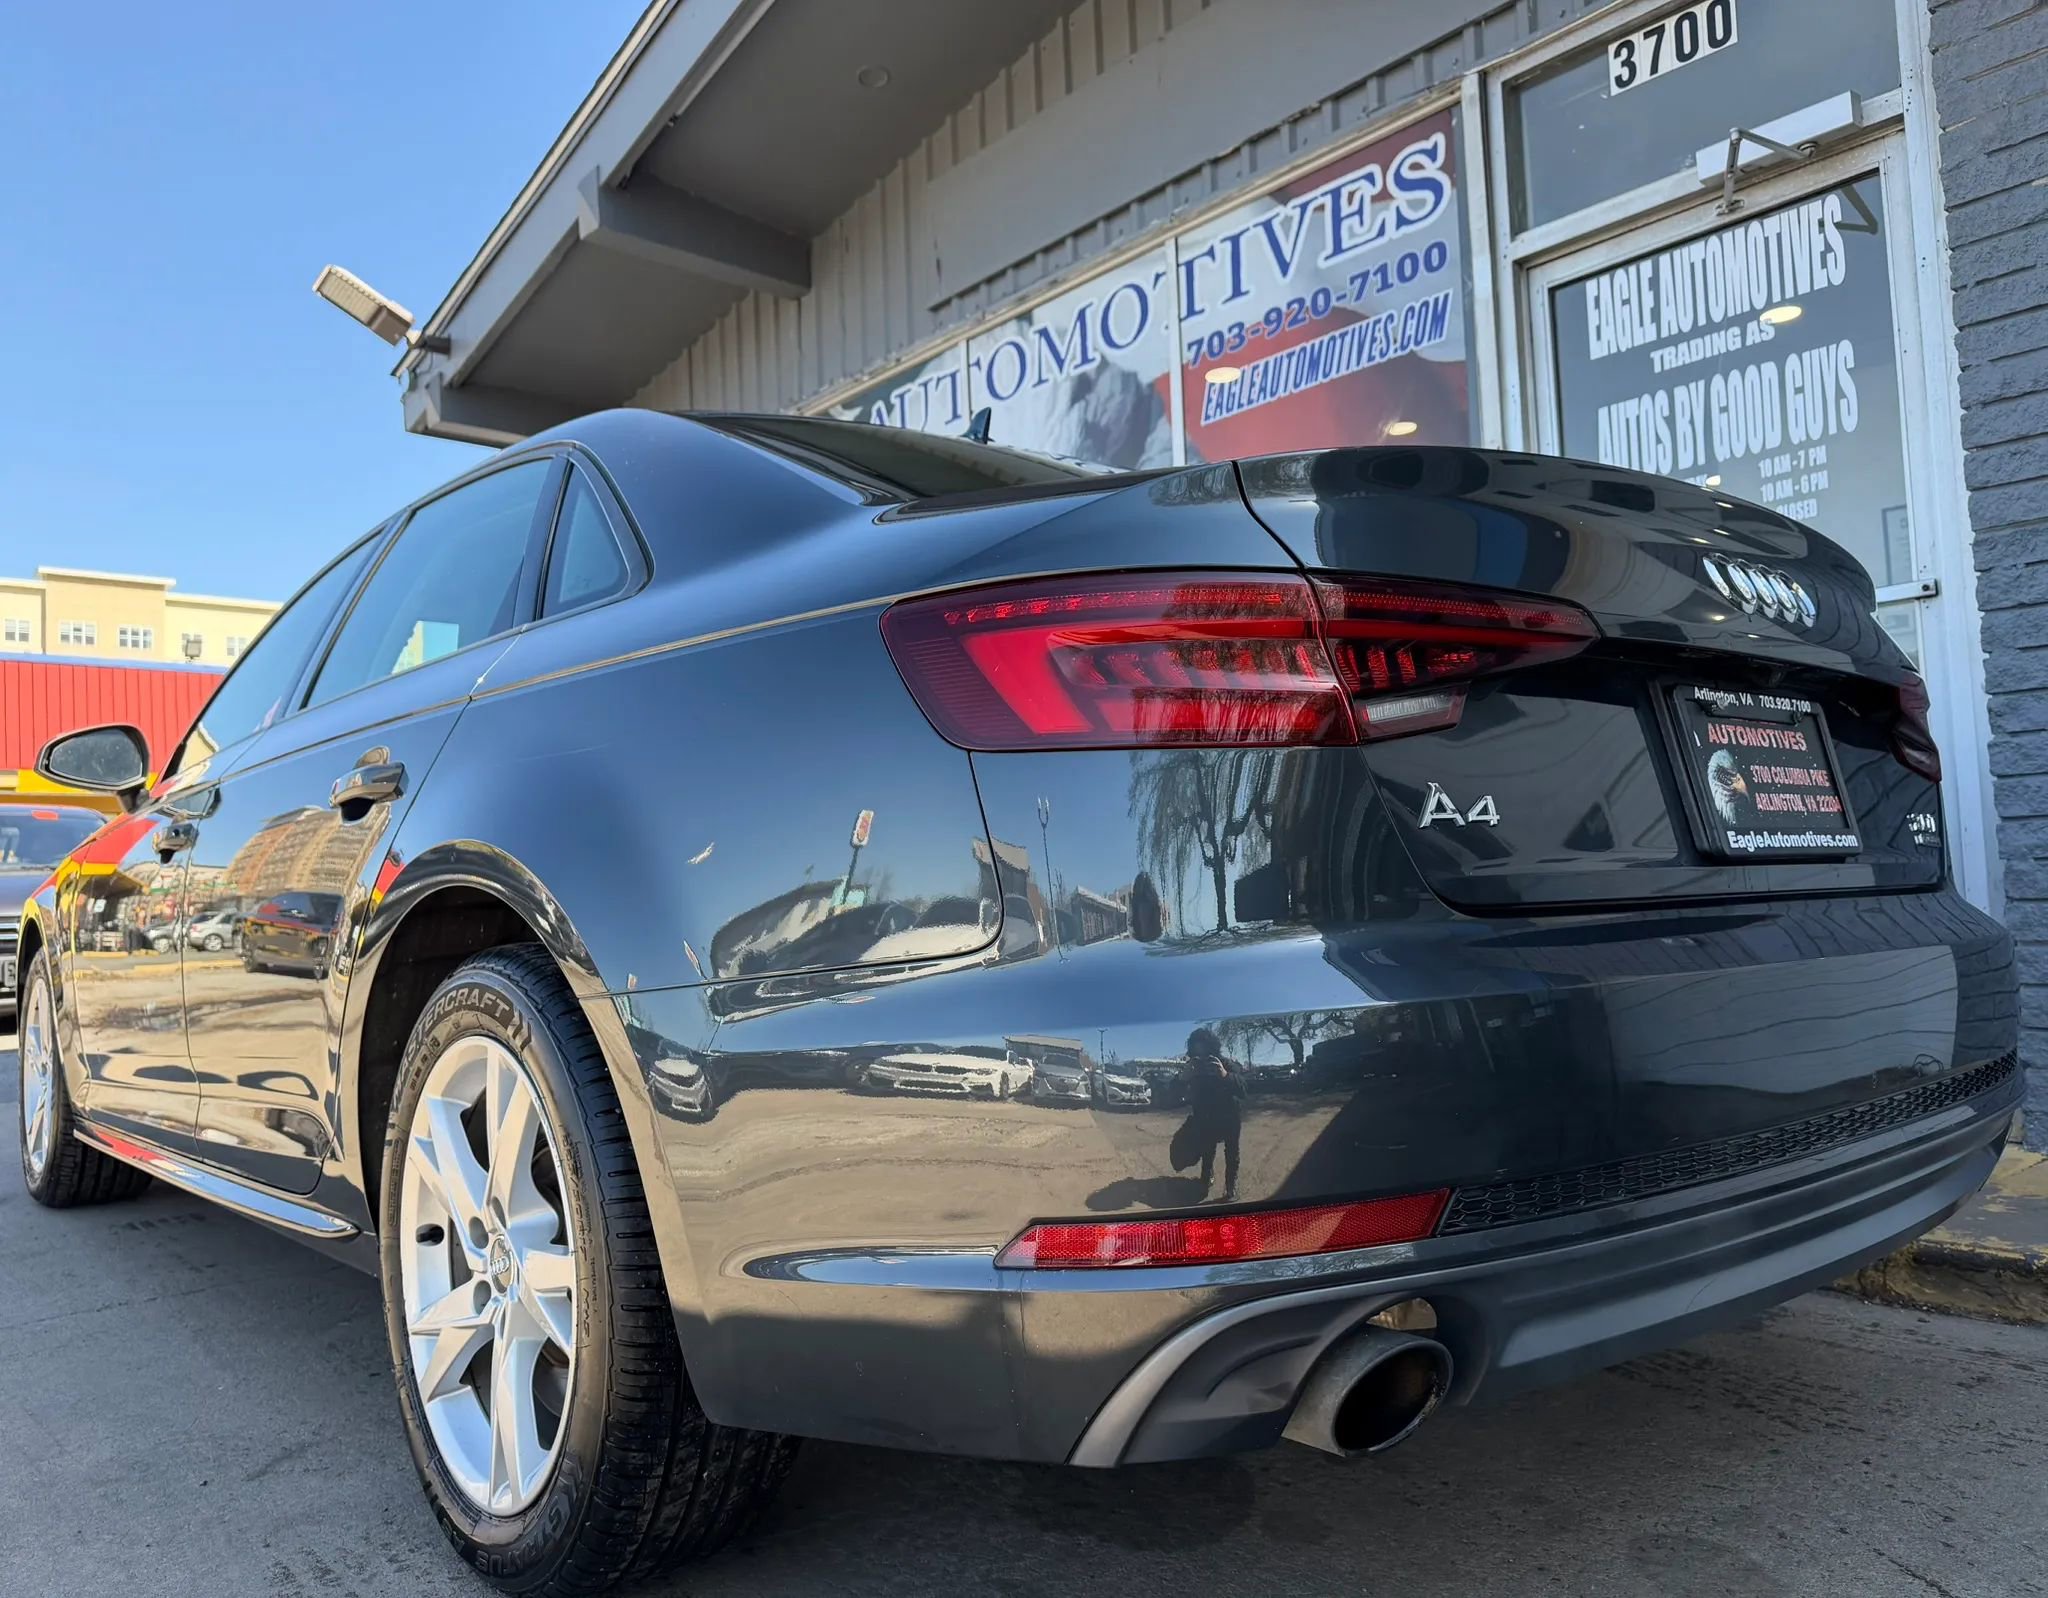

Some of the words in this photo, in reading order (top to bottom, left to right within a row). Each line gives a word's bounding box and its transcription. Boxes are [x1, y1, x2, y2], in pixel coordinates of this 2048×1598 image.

[1613, 0, 1732, 88] 3700
[1585, 259, 1657, 360] EAGLE
[1658, 194, 1846, 337] AUTOMOTIVES
[1187, 241, 1448, 367] 703-920-7100
[1202, 292, 1451, 424] EAGLEAUTOMOTIVES.COM
[1651, 325, 1742, 374] TRADING
[1746, 318, 1775, 347] AS
[1598, 389, 1674, 476] AUTOS
[1673, 380, 1706, 469] BY
[1710, 361, 1783, 463] GOOD
[1785, 339, 1859, 445] GUYS
[1758, 458, 1771, 478] 10
[1773, 453, 1791, 476] AM
[1799, 450, 1807, 470] 7
[1809, 445, 1827, 467] PM
[1760, 483, 1773, 503] 10
[1775, 477, 1793, 500] AM
[1801, 474, 1809, 494] 6
[1810, 469, 1829, 492] PM
[1739, 692, 1755, 706] VA
[1759, 695, 1812, 712] 703.920.7100
[1707, 722, 1808, 751] AUTOMOTIVES
[1418, 782, 1500, 829] A4
[1727, 831, 1859, 852] EagleAutomotives.com
